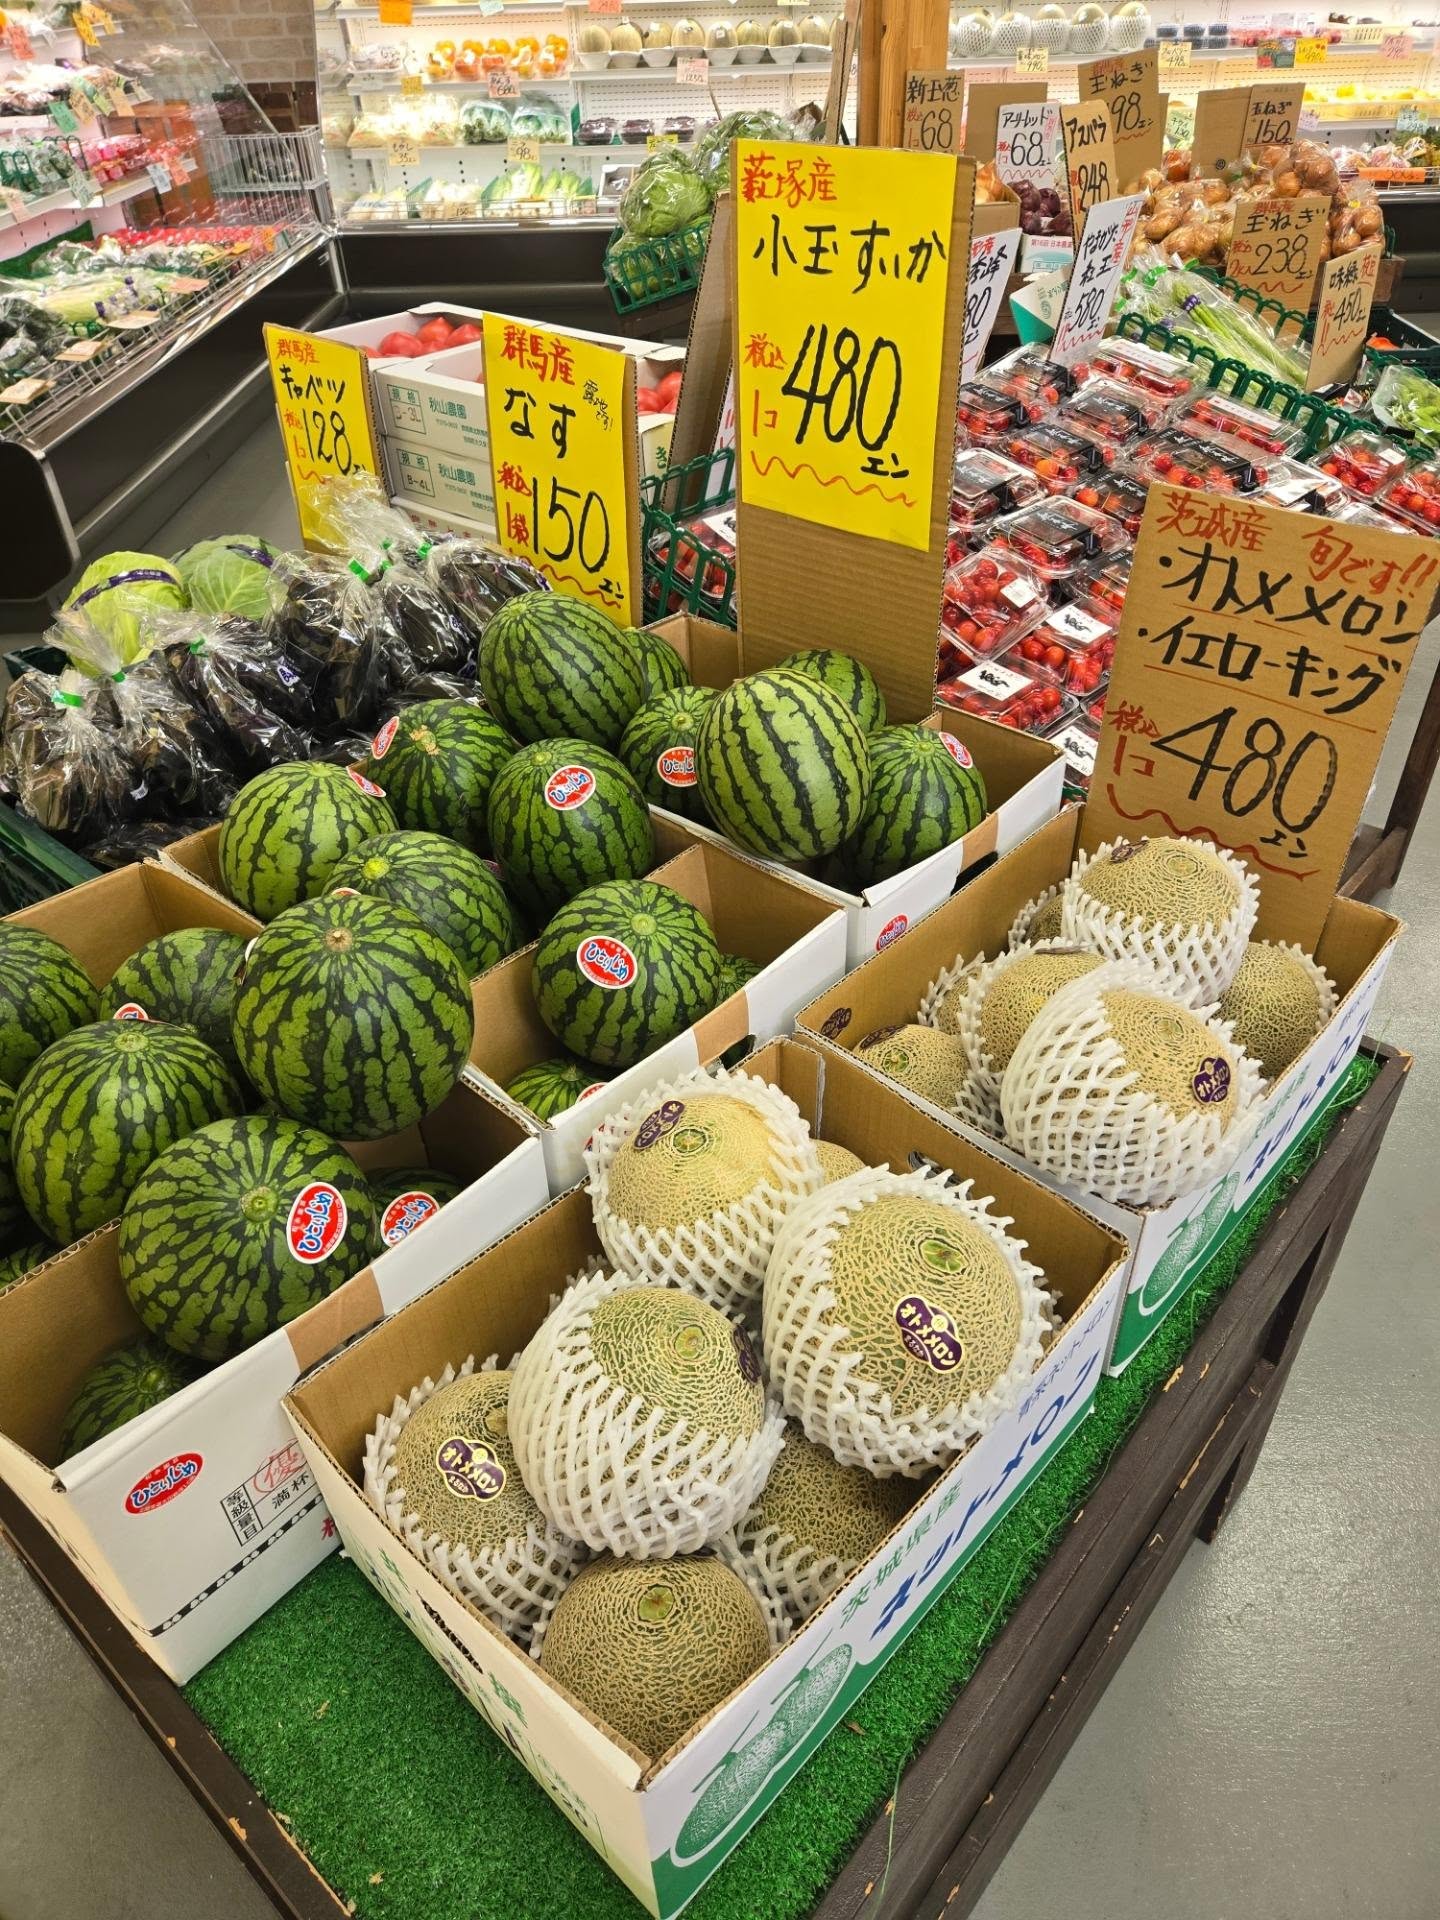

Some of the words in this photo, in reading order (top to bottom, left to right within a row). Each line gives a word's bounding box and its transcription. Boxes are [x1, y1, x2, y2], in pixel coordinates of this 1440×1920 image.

[906, 75, 962, 104] 新玉葱
[1089, 61, 1153, 94] 玉ねぎ
[921, 108, 953, 150] 68
[1137, 118, 1154, 129] エン
[1251, 100, 1292, 116] 玉ねぎ
[1010, 131, 1044, 166] 68
[1065, 114, 1107, 153] アスパラ
[1254, 119, 1291, 143] 150
[1082, 222, 1119, 260] やまがた
[1242, 207, 1327, 234] 玉ねぎ
[753, 213, 947, 295] 小玉すいか
[1251, 234, 1309, 277] 238
[1070, 287, 1106, 332] 580
[1333, 287, 1363, 331] 450
[275, 338, 320, 366] 群馬産
[500, 324, 576, 386] 群馬産
[744, 332, 788, 371] 税込
[279, 363, 346, 405] キャベツ
[781, 322, 903, 453] 480
[503, 387, 577, 460] なす
[751, 388, 779, 438] 1コ
[302, 407, 353, 476] 128
[860, 452, 910, 479] エン
[532, 475, 610, 574] 150
[1155, 490, 1274, 553] 茨城産
[1301, 524, 1438, 600] 旬です!!
[598, 577, 625, 600] エン
[1105, 699, 1162, 738] 税込
[1112, 734, 1157, 779] 1コ
[1149, 705, 1339, 834] 480
[549, 770, 591, 804] ひとりじめ
[1259, 828, 1312, 858] エン
[584, 942, 629, 981] ひとりじめ
[298, 1191, 334, 1252] ひとりじめ
[900, 1303, 956, 1366] オトメメロン
[131, 1460, 198, 1508] ひとりじめ
[442, 1446, 499, 1494] オトメメロン
[870, 1348, 1101, 1642] ネットメロン
[839, 1475, 964, 1630] 茨城県産
